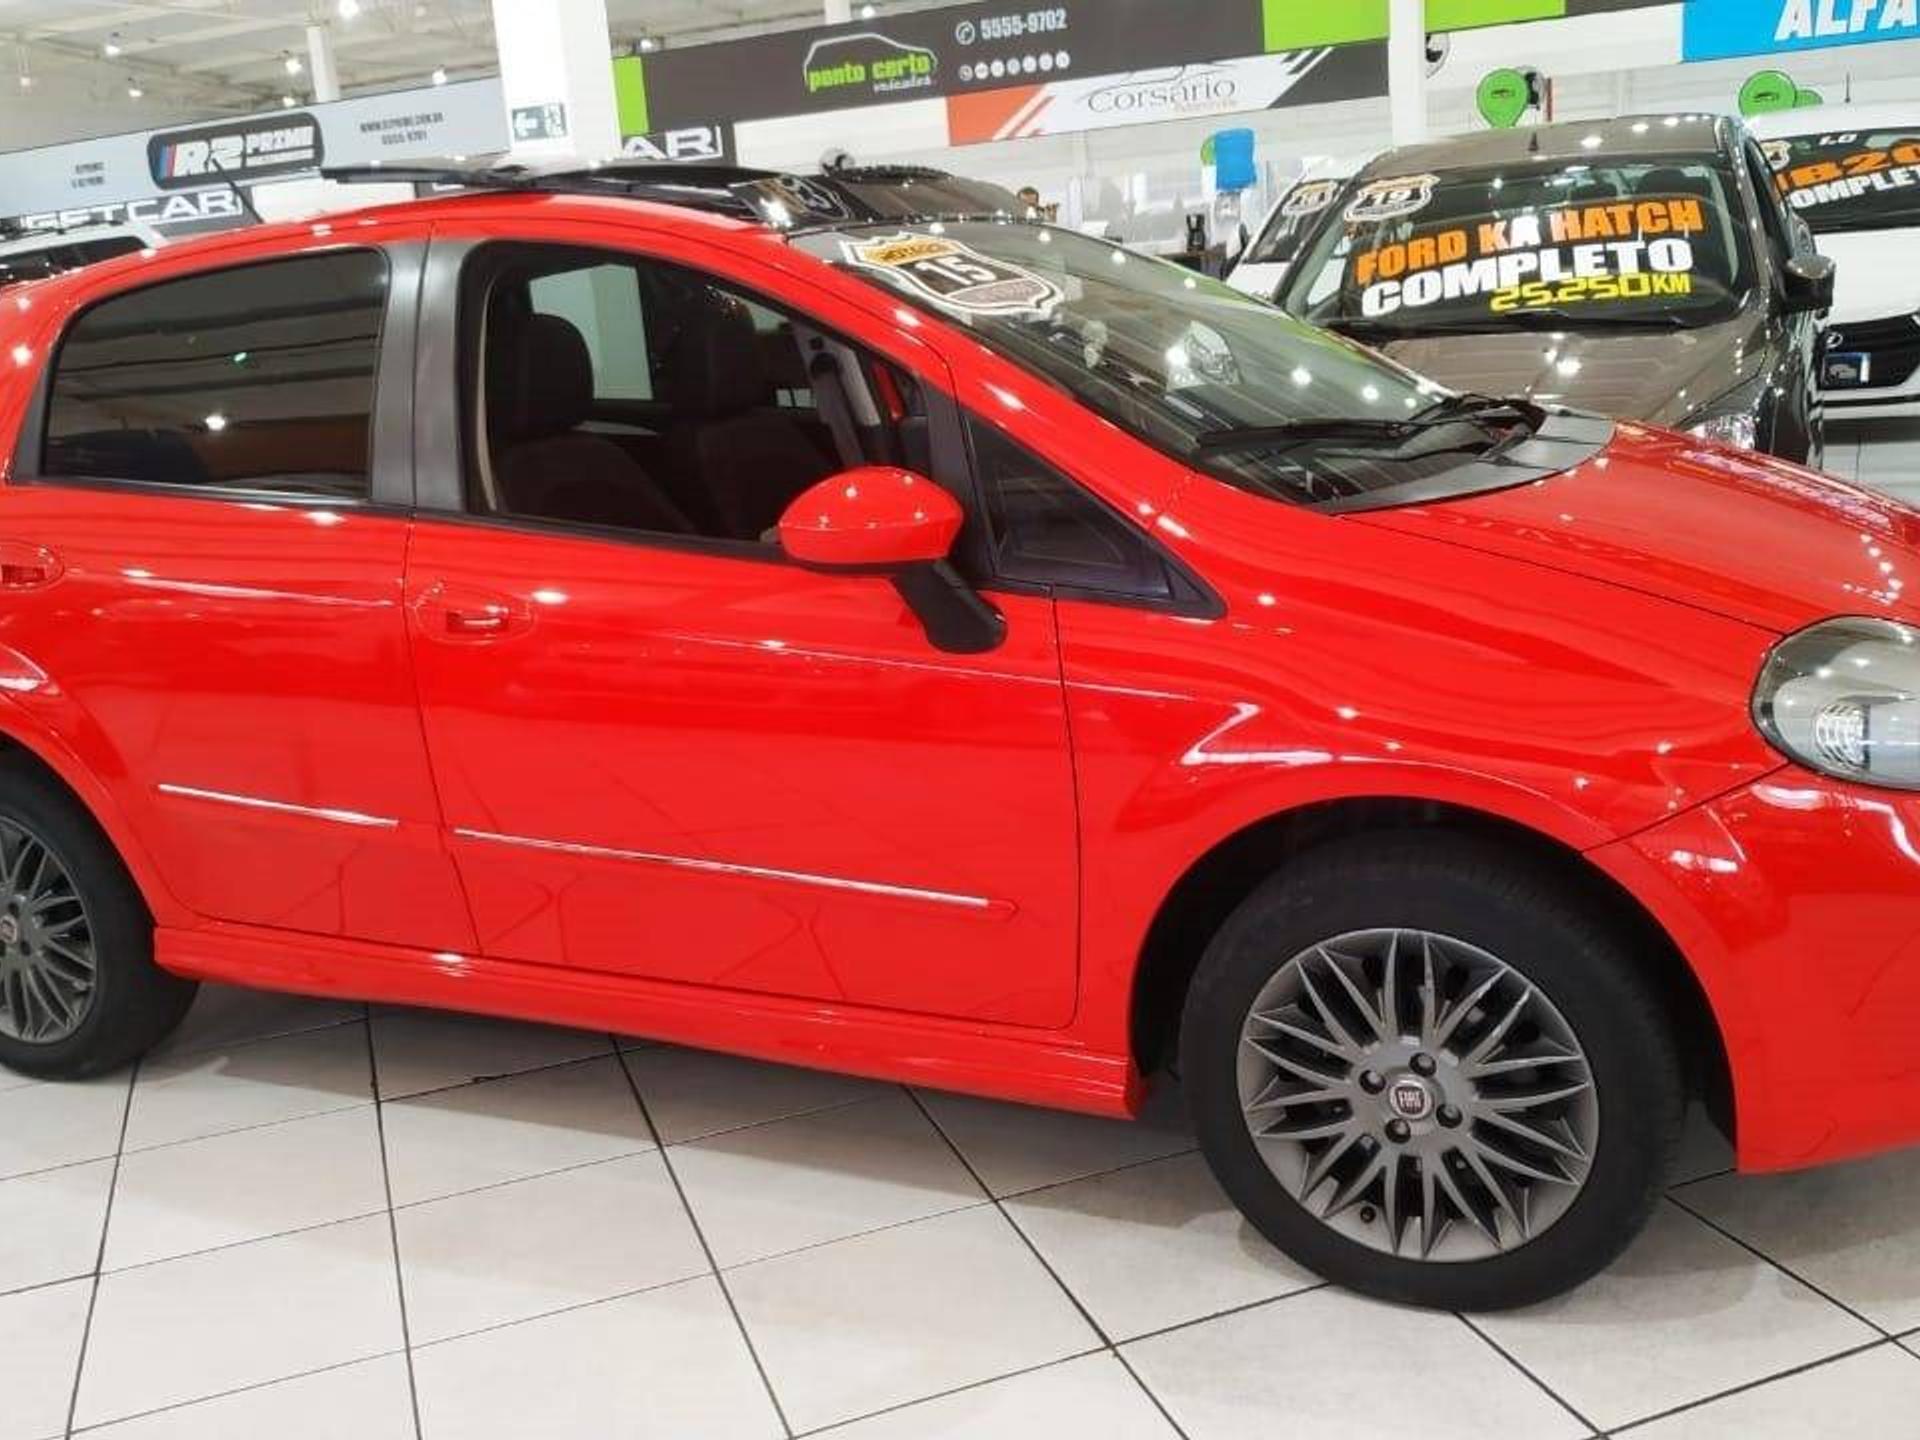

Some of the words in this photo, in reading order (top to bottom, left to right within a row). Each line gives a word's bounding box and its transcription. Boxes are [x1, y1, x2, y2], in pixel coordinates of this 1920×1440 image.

[981, 8, 1067, 39] 5555-9702
[1788, 163, 1920, 209] OMPLE
[1357, 231, 1468, 283] FORD
[1478, 214, 1540, 249] KA
[1551, 200, 1703, 242] HATCH
[915, 256, 996, 285] 15
[1362, 239, 1694, 317] COMPLETO
